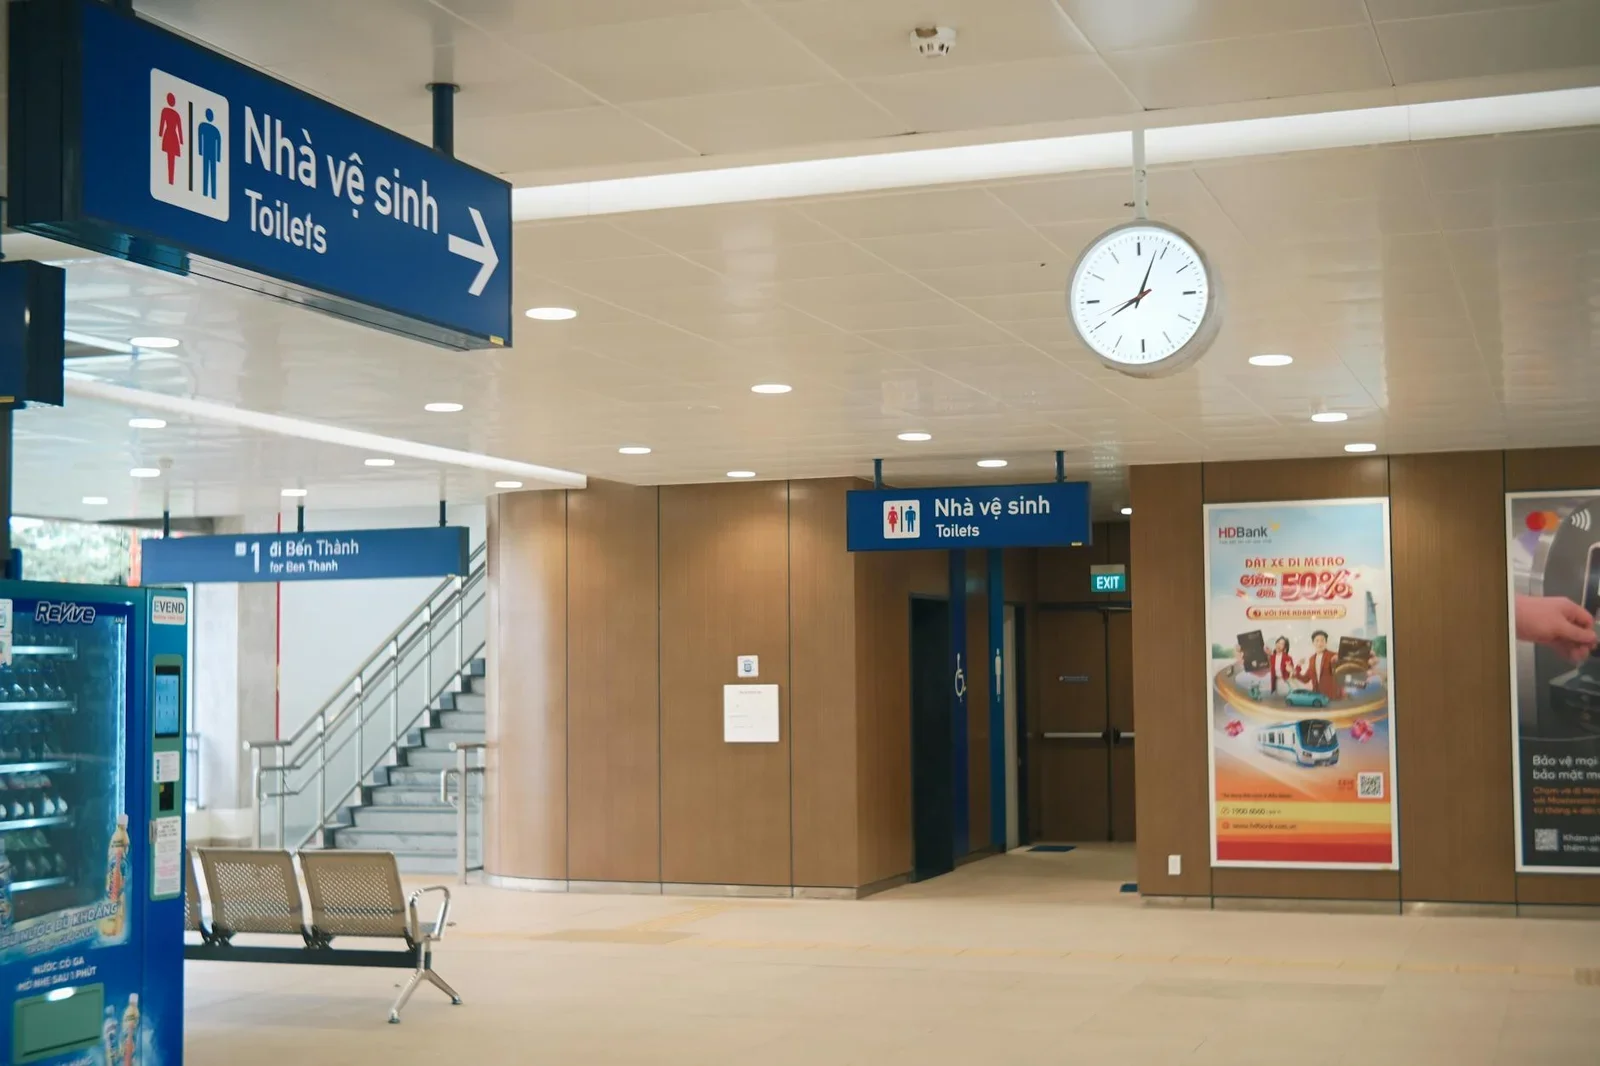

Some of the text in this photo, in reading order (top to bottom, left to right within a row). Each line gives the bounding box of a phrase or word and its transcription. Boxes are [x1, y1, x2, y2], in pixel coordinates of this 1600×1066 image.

[245, 105, 439, 235] Nhà vệ sinh
[244, 188, 328, 254] Toilets
[934, 495, 1051, 520] Nhà vệ sinh
[935, 524, 980, 538] Toilets
[1218, 526, 1268, 539] HDBank
[269, 540, 282, 557] đi
[286, 538, 312, 557] Bến
[316, 538, 359, 556] Thành
[270, 559, 338, 573] for Ben Thanh
[1304, 556, 1345, 567] METRO
[1096, 575, 1120, 590] EXIT
[1280, 570, 1353, 602] 50%
[153, 600, 185, 615] EVEND
